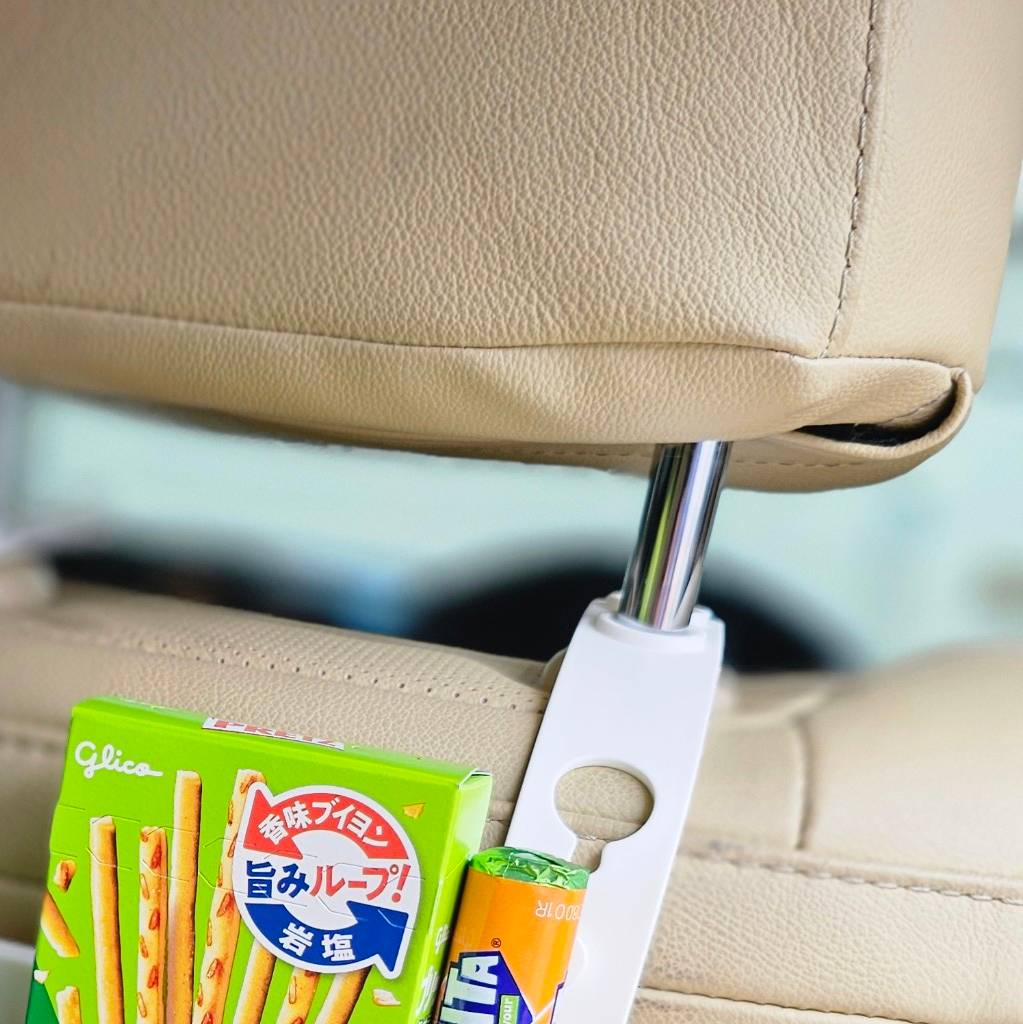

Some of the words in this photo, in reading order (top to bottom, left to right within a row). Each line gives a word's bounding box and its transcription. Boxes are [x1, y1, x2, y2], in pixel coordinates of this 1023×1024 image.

[75, 740, 163, 779] Glico
[257, 797, 389, 846] 香味ブイヨン
[246, 860, 412, 904] 旨みループ!
[278, 921, 357, 962] 岩塩
